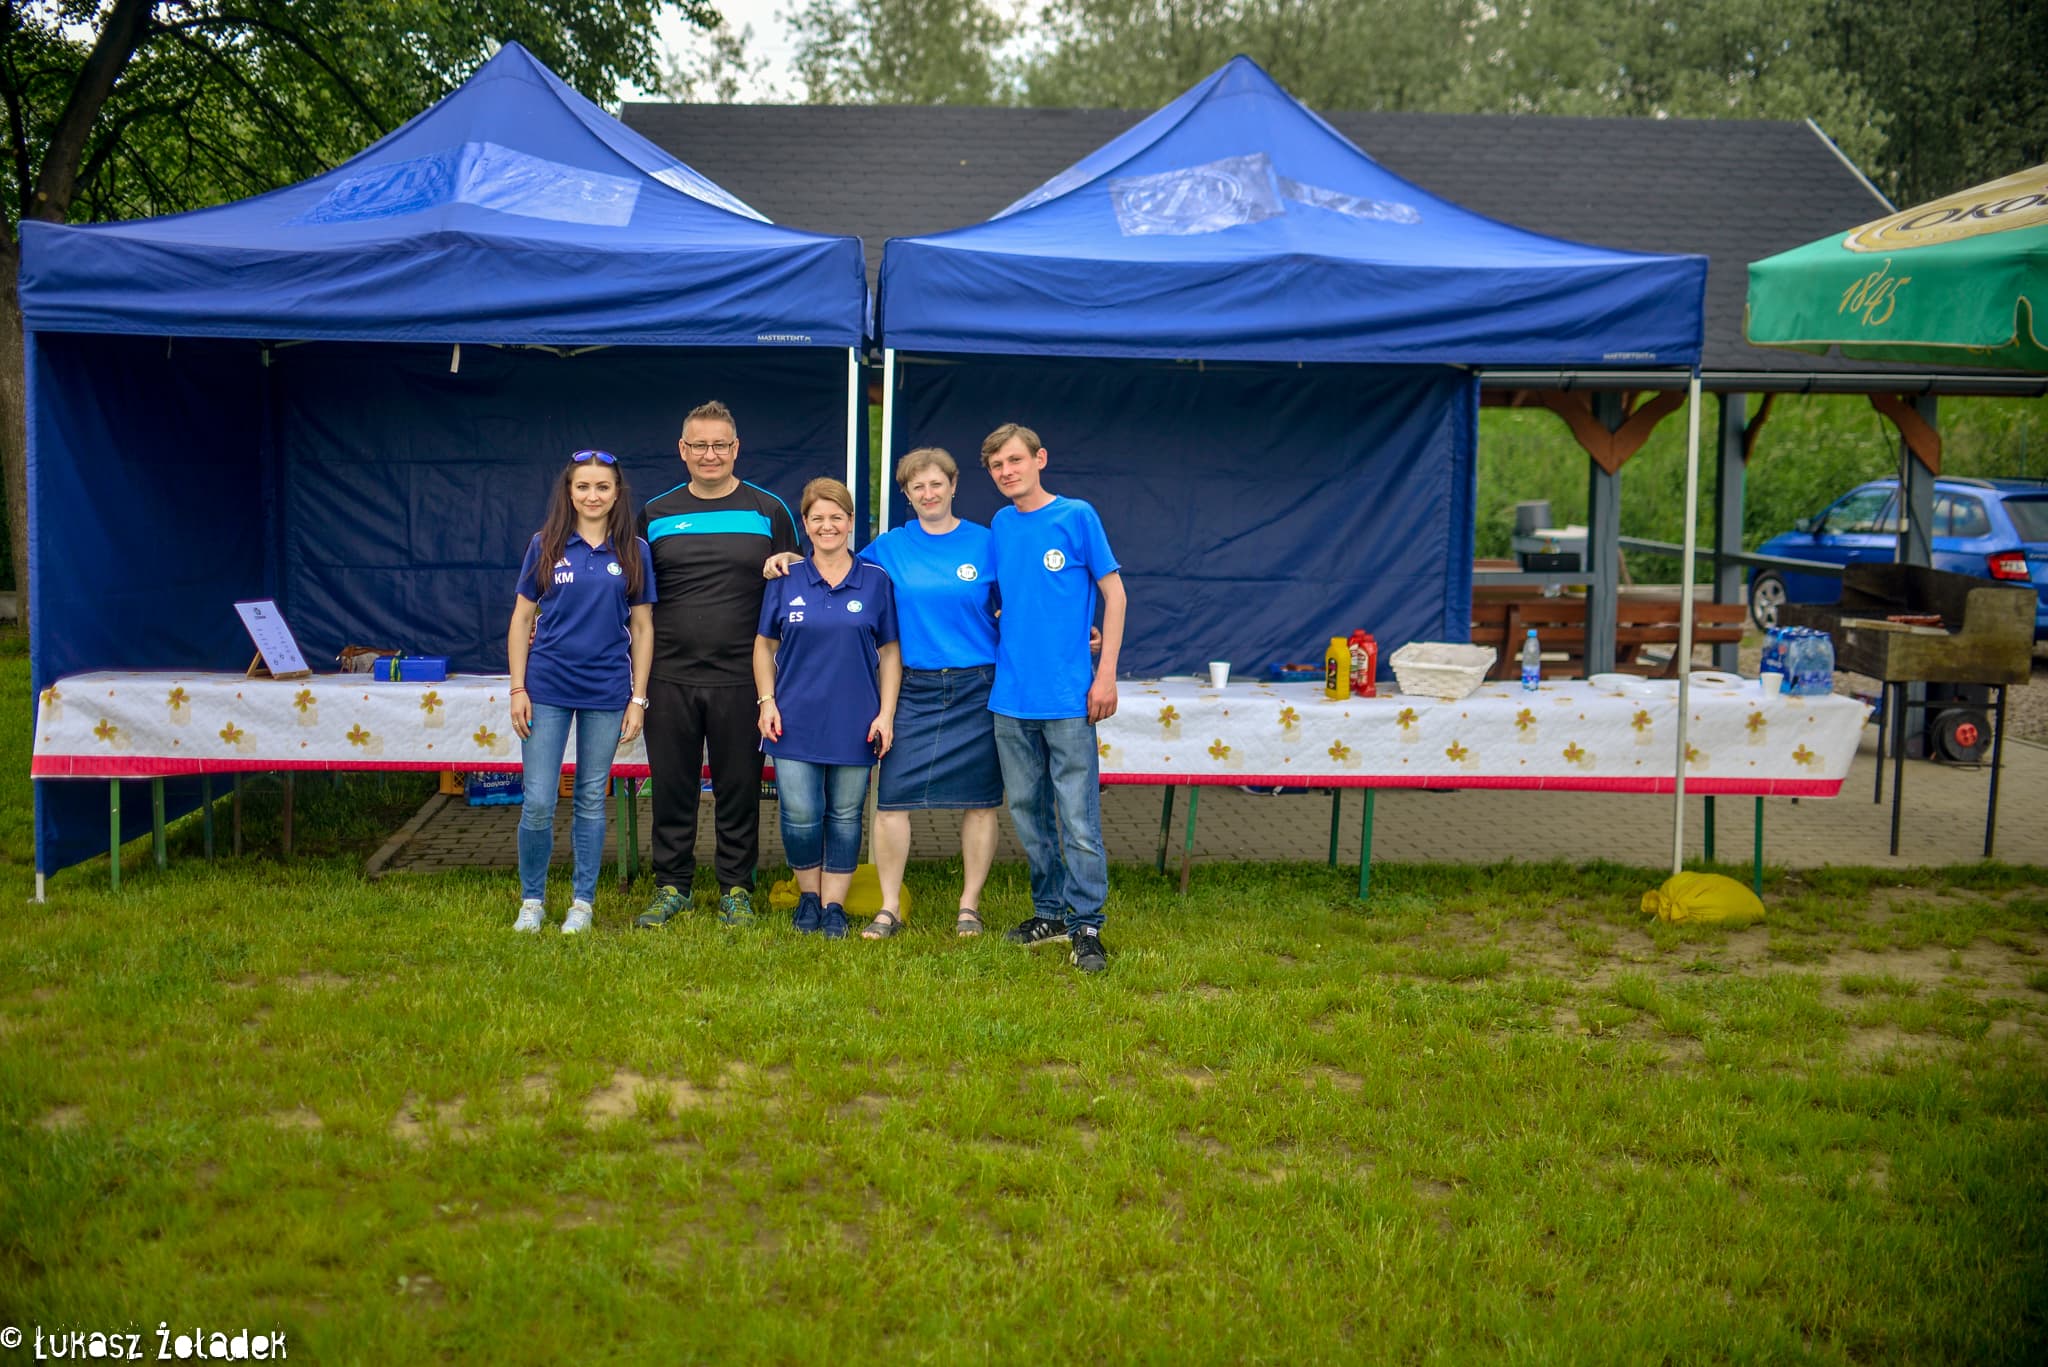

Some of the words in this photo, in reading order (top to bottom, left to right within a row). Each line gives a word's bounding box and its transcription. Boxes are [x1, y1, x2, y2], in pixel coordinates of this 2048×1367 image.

[1896, 194, 2048, 231] OKO
[1838, 258, 1912, 326] 1845
[554, 572, 574, 585] KM
[789, 611, 804, 623] ES
